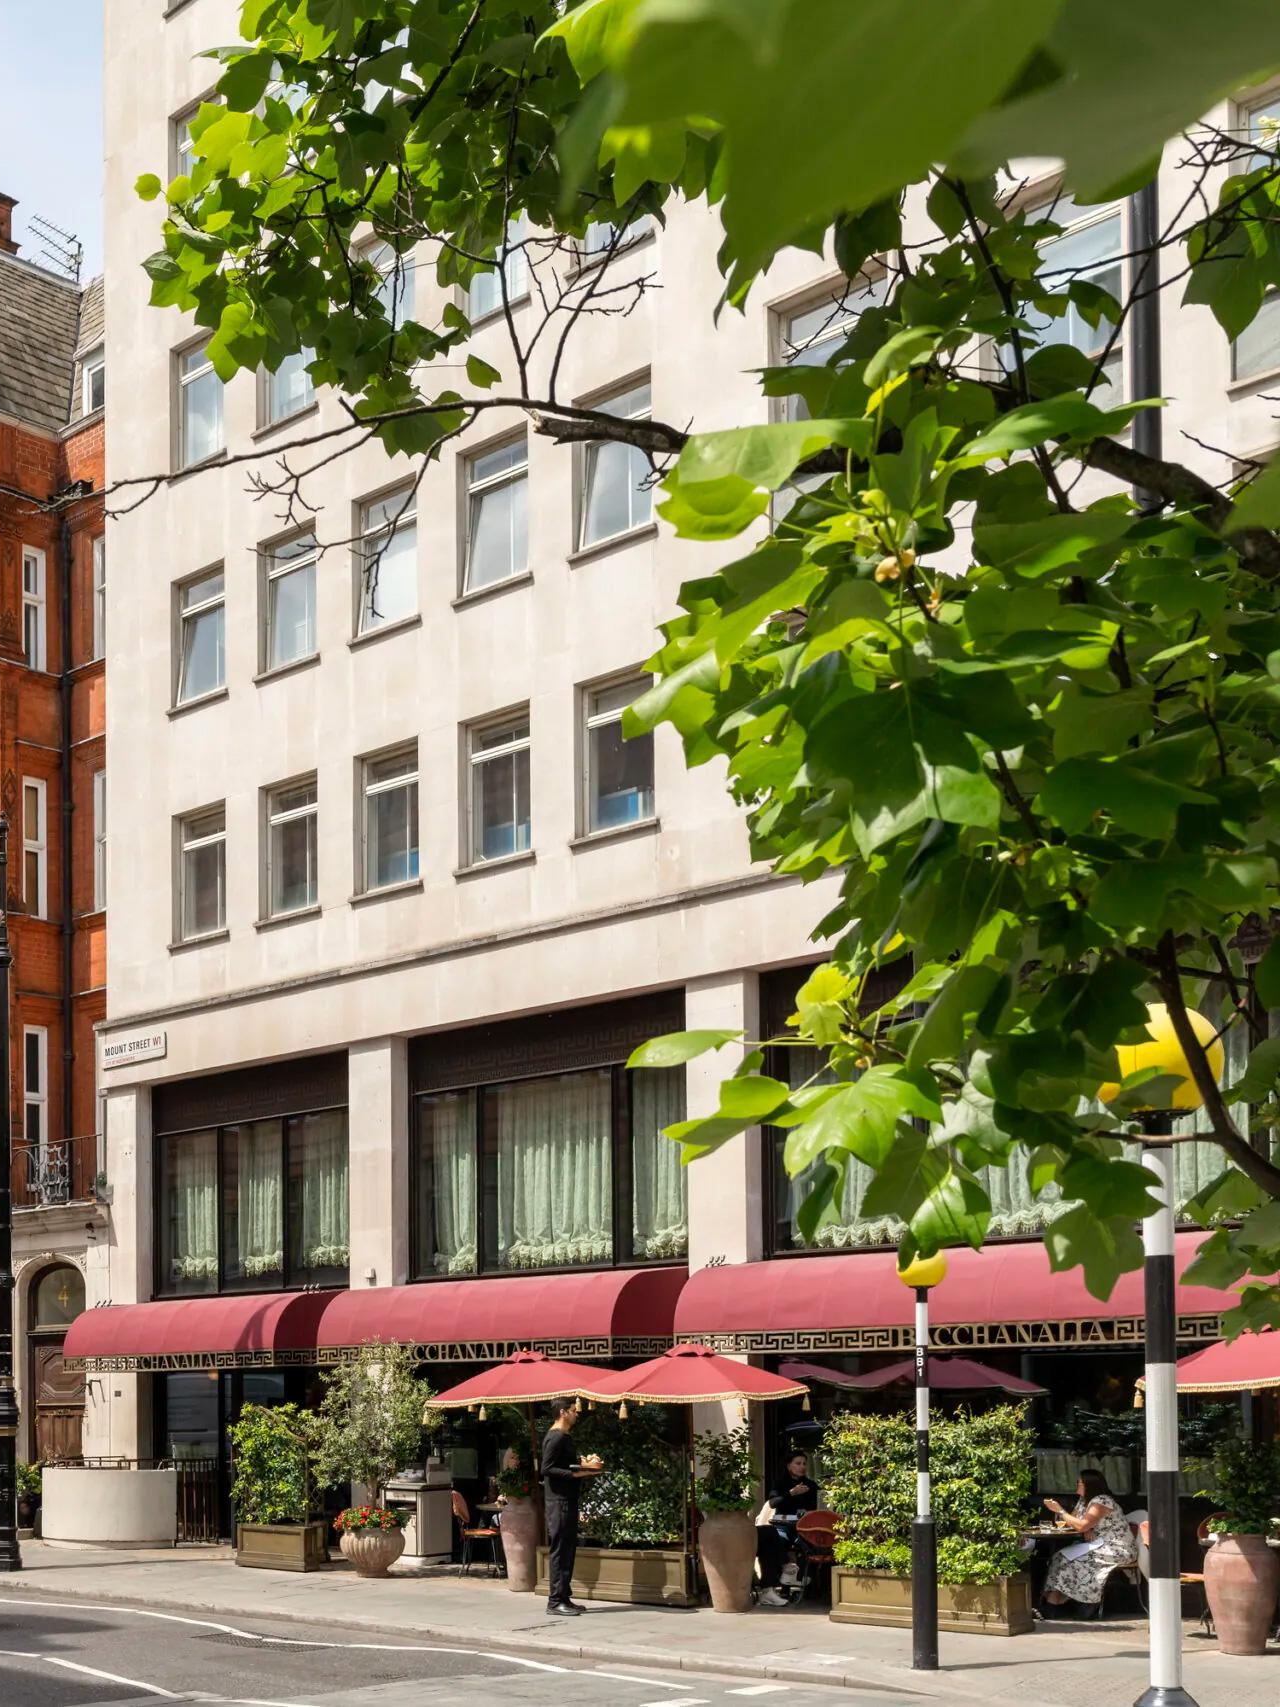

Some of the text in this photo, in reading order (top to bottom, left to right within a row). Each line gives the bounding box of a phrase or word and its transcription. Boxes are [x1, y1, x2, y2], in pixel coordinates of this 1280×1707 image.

[104, 1036, 162, 1057] MOUNT STREET W1
[57, 1285, 70, 1309] 4
[404, 1341, 523, 1362] CCHANALIA
